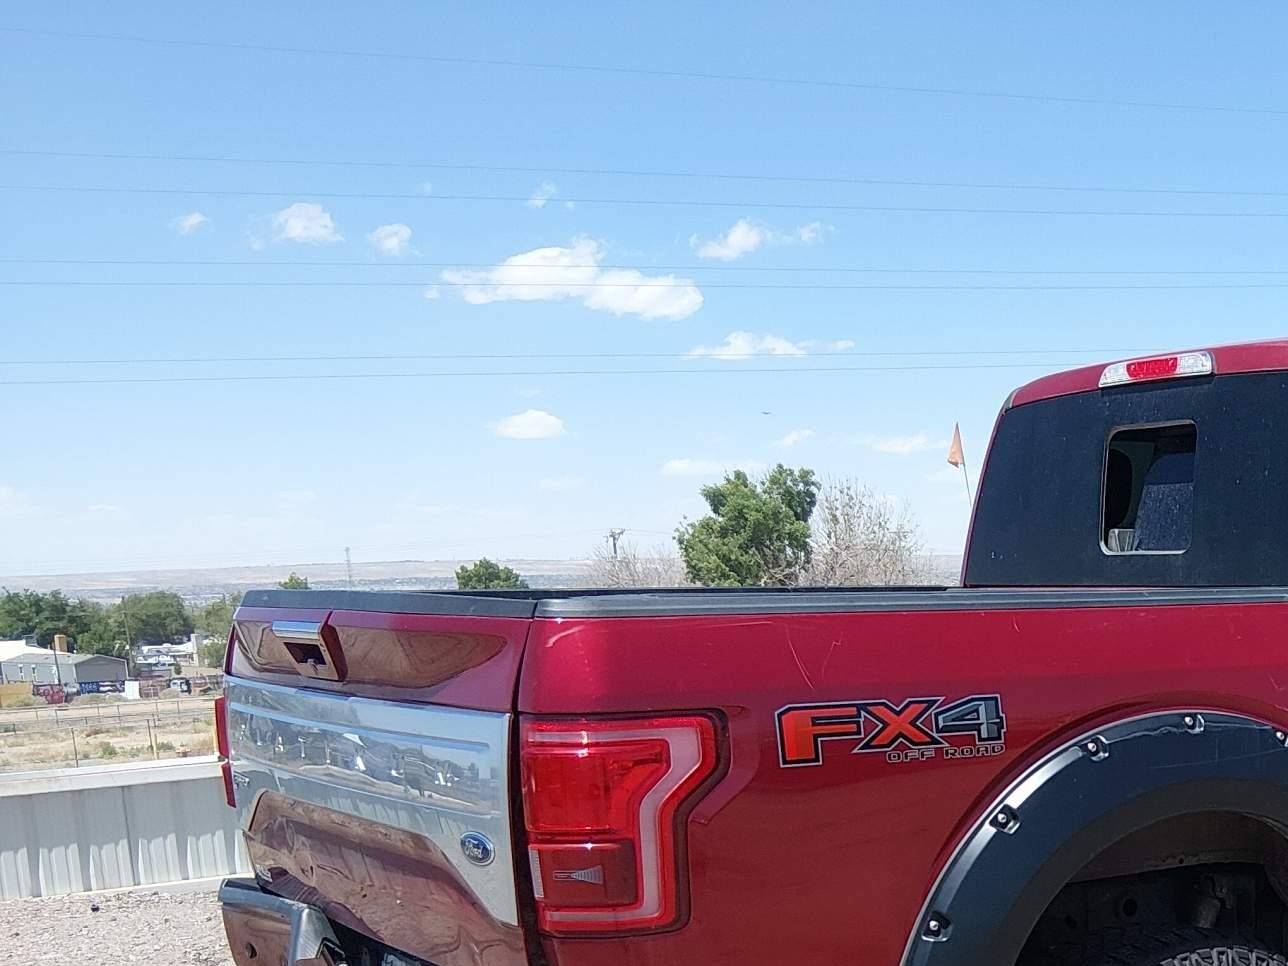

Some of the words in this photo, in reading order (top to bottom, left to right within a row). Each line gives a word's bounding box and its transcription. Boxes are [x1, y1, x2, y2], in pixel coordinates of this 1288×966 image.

[775, 694, 1006, 768] FX4
[886, 749, 935, 763] OFF
[943, 743, 1006, 760] ROAD
